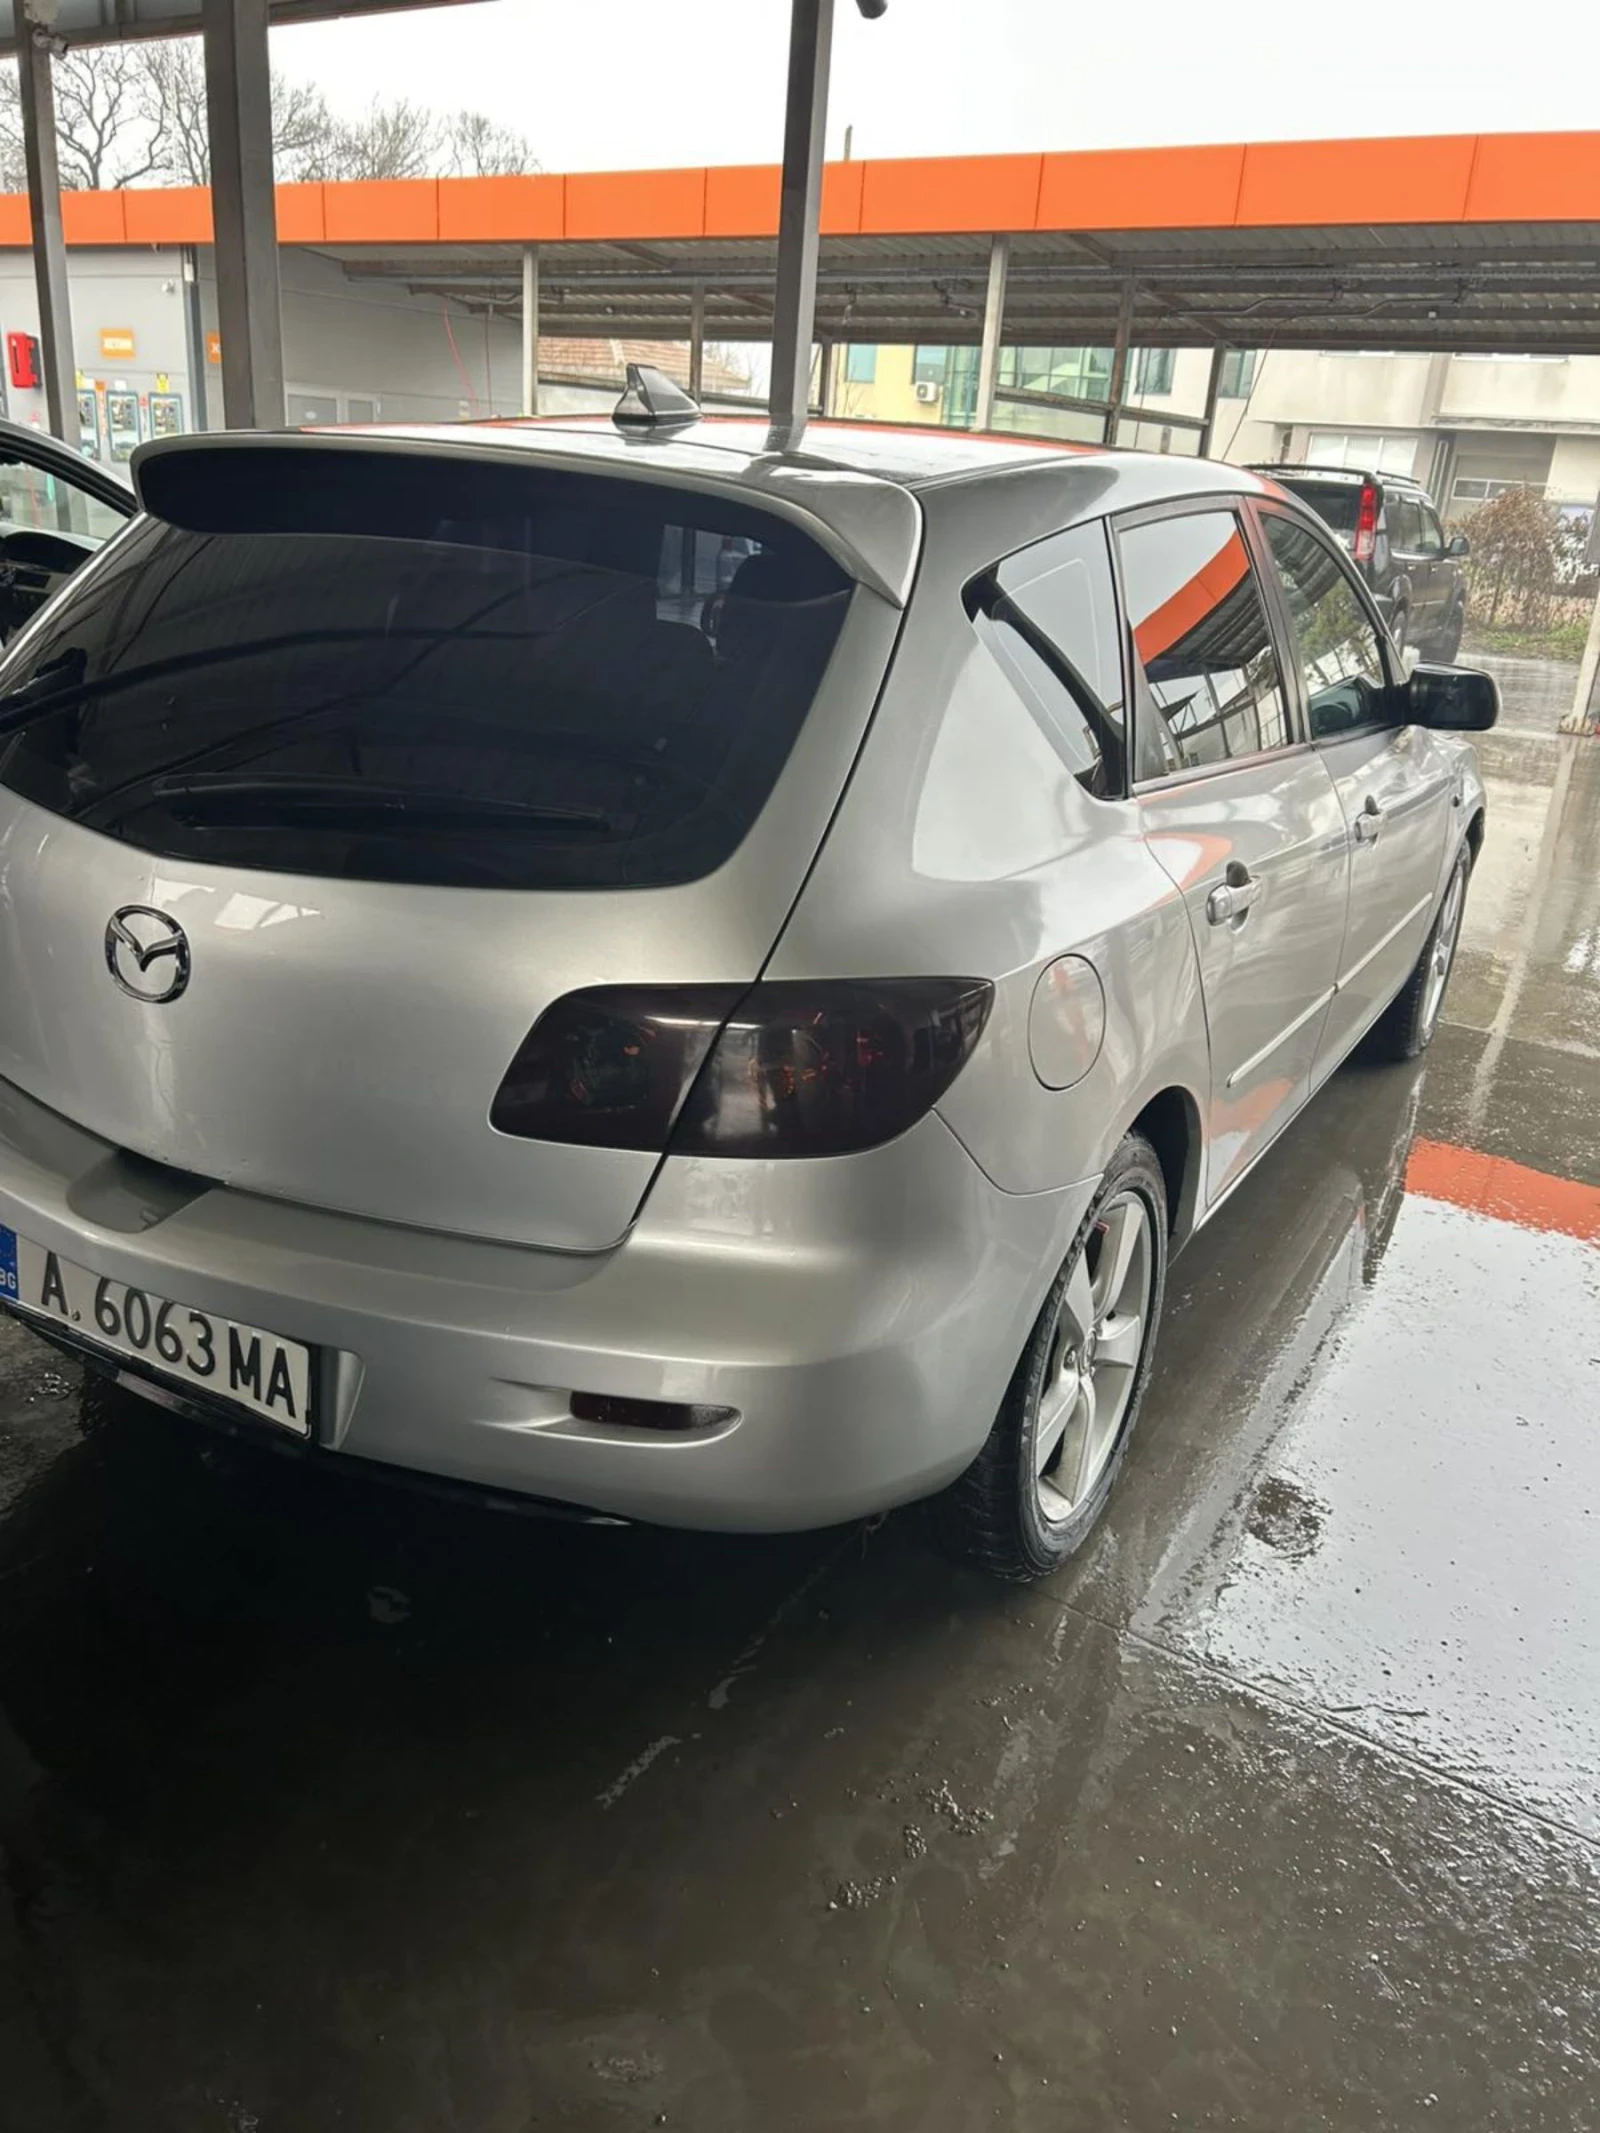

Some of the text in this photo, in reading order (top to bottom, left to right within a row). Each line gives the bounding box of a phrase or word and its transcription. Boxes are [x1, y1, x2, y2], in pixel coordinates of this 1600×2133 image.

[0, 1267, 17, 1290] BG
[94, 1277, 216, 1376] 6063
[228, 1325, 297, 1419] MA
